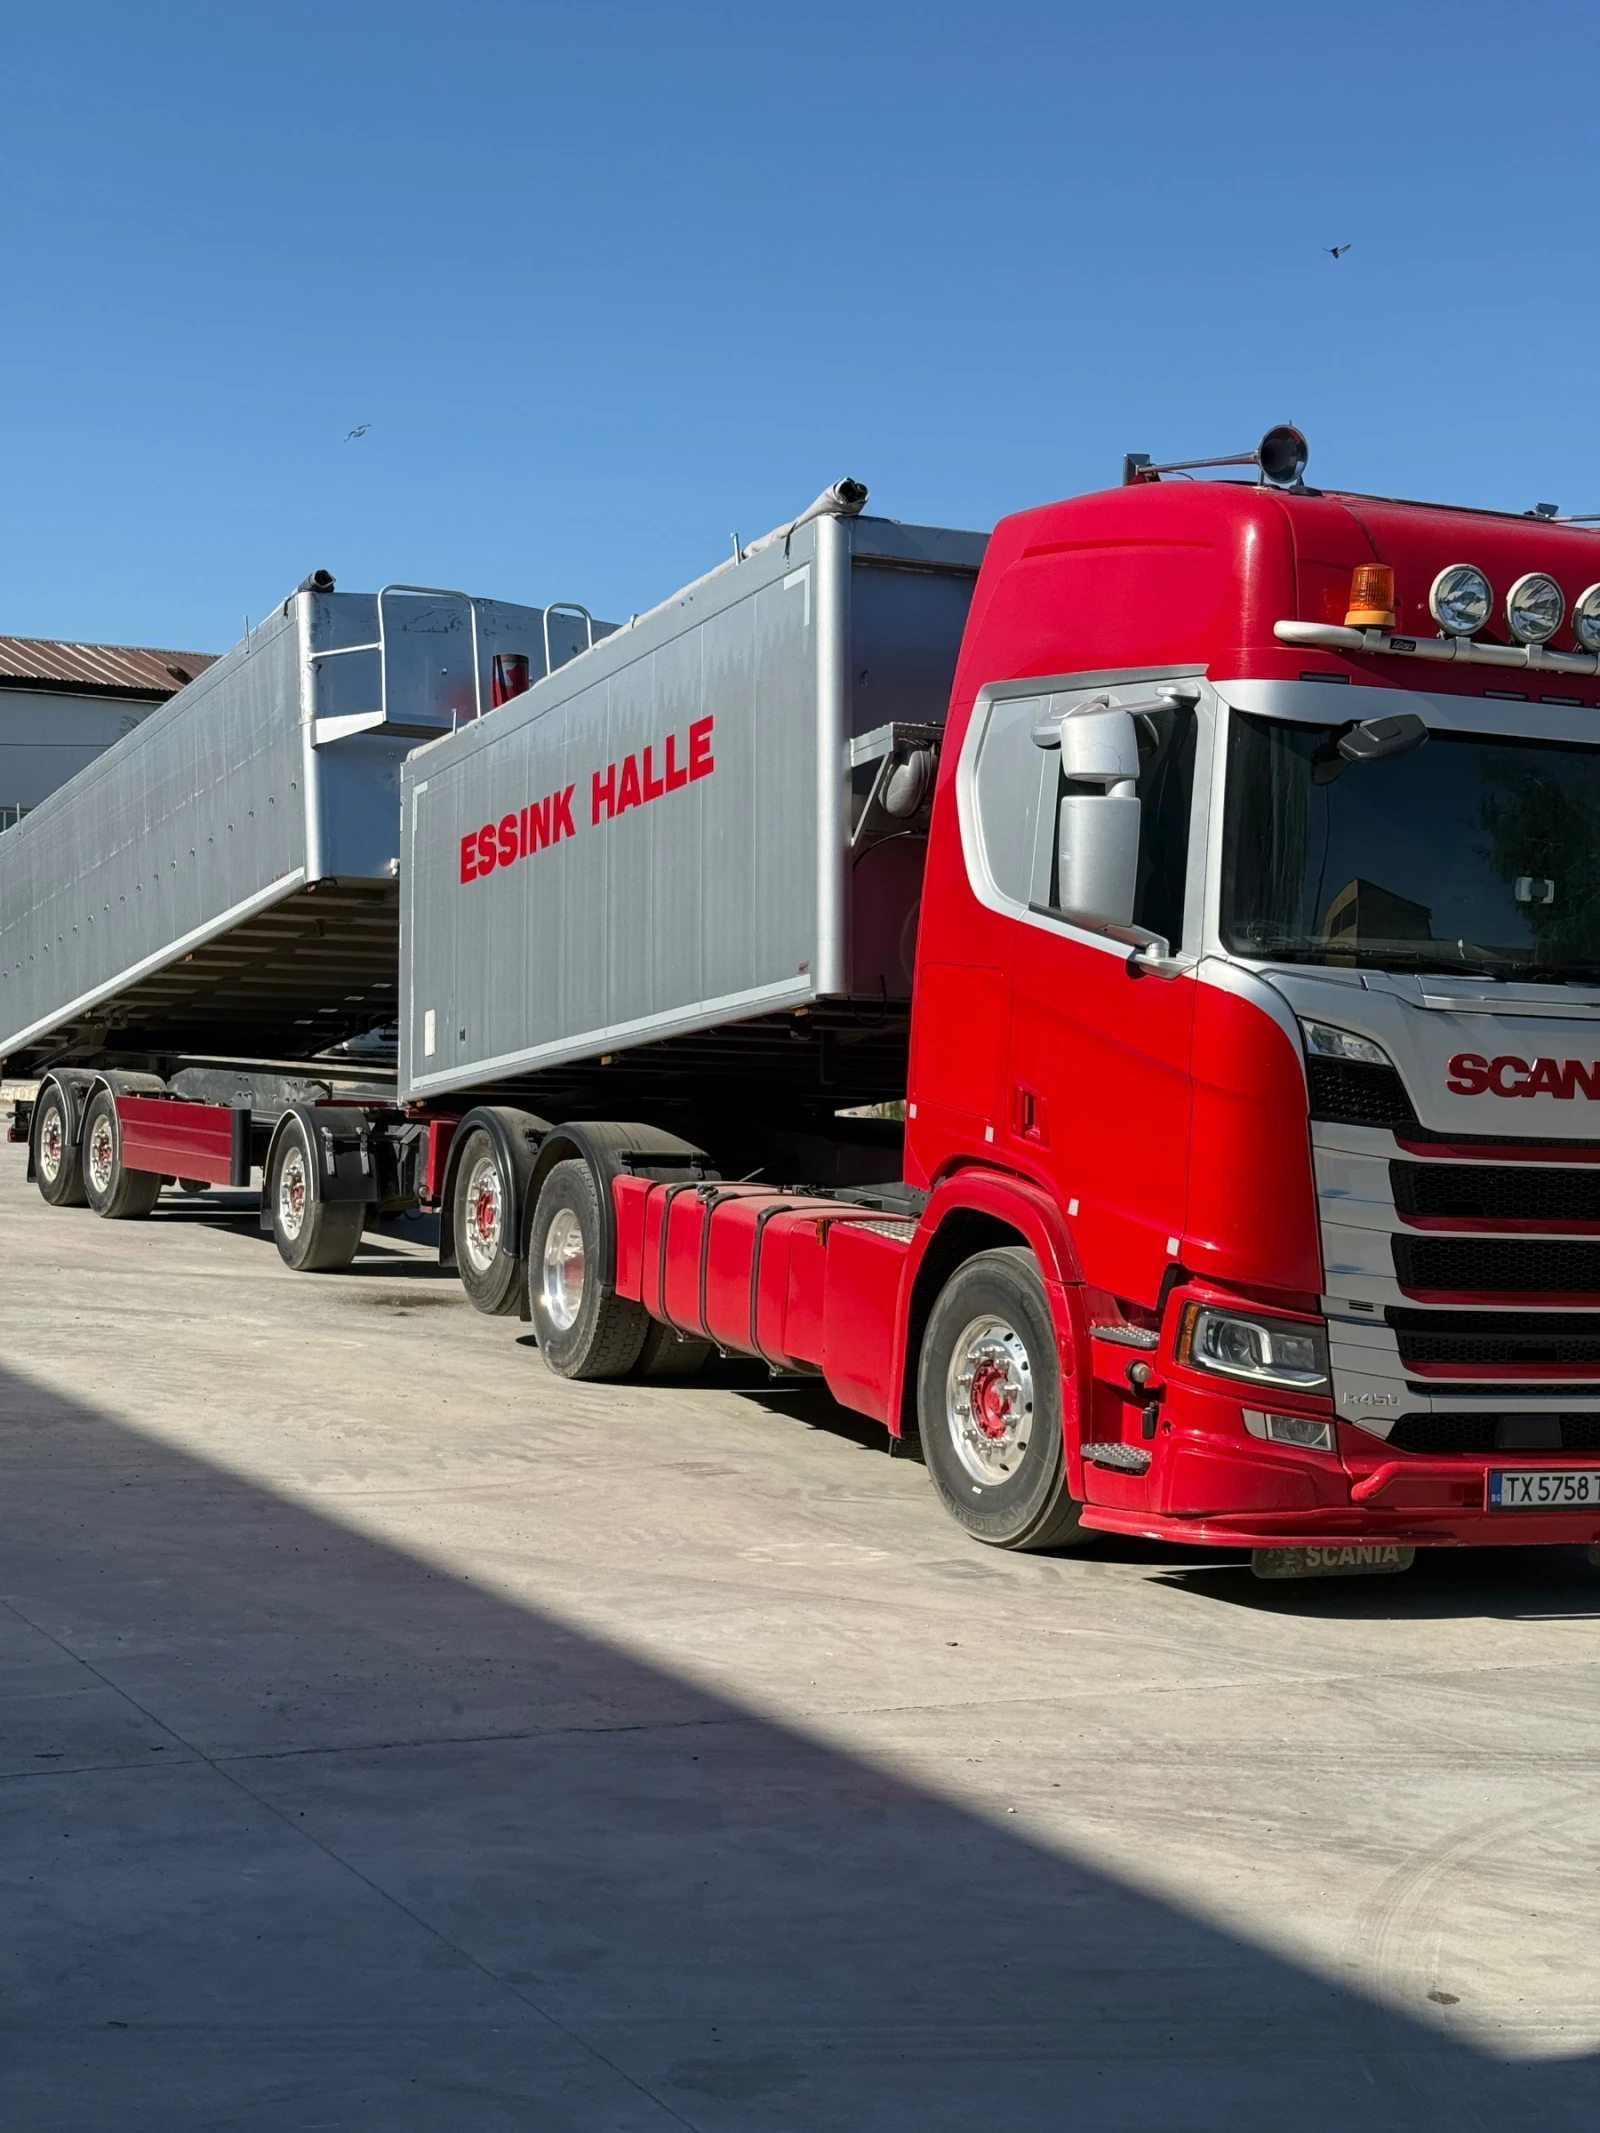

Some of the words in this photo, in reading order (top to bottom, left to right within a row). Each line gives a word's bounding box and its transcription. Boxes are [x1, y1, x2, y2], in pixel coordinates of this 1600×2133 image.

[460, 783, 576, 885] ESSINK
[591, 714, 714, 826] HALLE
[1445, 1053, 1600, 1100] SCAN
[1305, 1546, 1399, 1567] SCANIA
